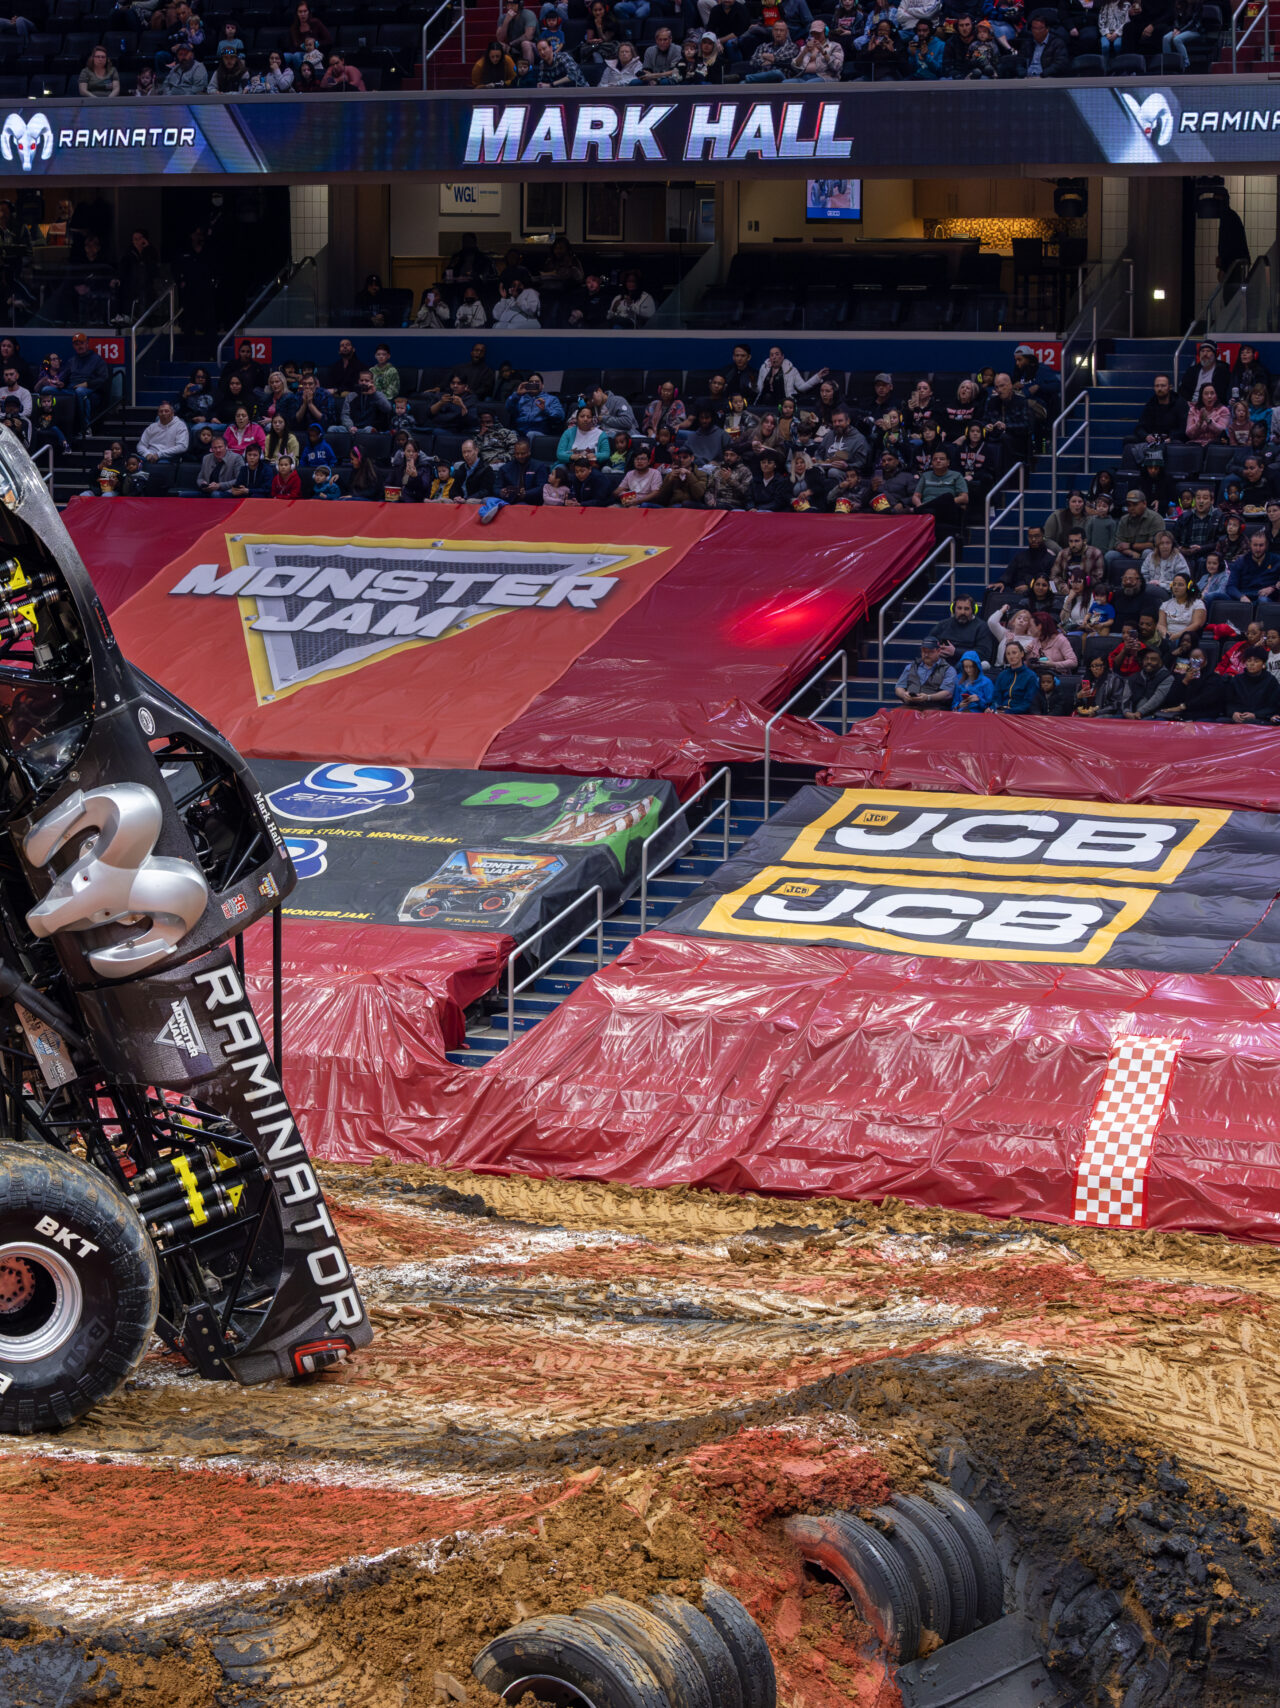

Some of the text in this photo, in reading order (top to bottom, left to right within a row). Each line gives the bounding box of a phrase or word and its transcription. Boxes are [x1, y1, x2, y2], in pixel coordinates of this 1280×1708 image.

[58, 127, 195, 148] RAMINATOR
[463, 101, 854, 163] MARK HALL
[454, 186, 476, 202] WGL
[95, 343, 119, 359] 113
[251, 343, 266, 359] 12
[1034, 348, 1055, 365] 12
[168, 564, 619, 609] MONSTER
[250, 600, 463, 638] JAM
[254, 791, 282, 846] Mark Hall
[865, 813, 887, 822] JCB
[368, 831, 427, 842] MONSTER
[835, 813, 1177, 863] JCB
[471, 862, 537, 870] MONSTER
[786, 886, 808, 894] JCB
[281, 908, 341, 917] MONSTER
[753, 889, 1103, 945] JCB
[168, 1021, 186, 1047] JAM
[170, 1000, 199, 1058] MONSTER
[195, 964, 362, 1332] RAMINATOR
[34, 1215, 99, 1258] BKT
